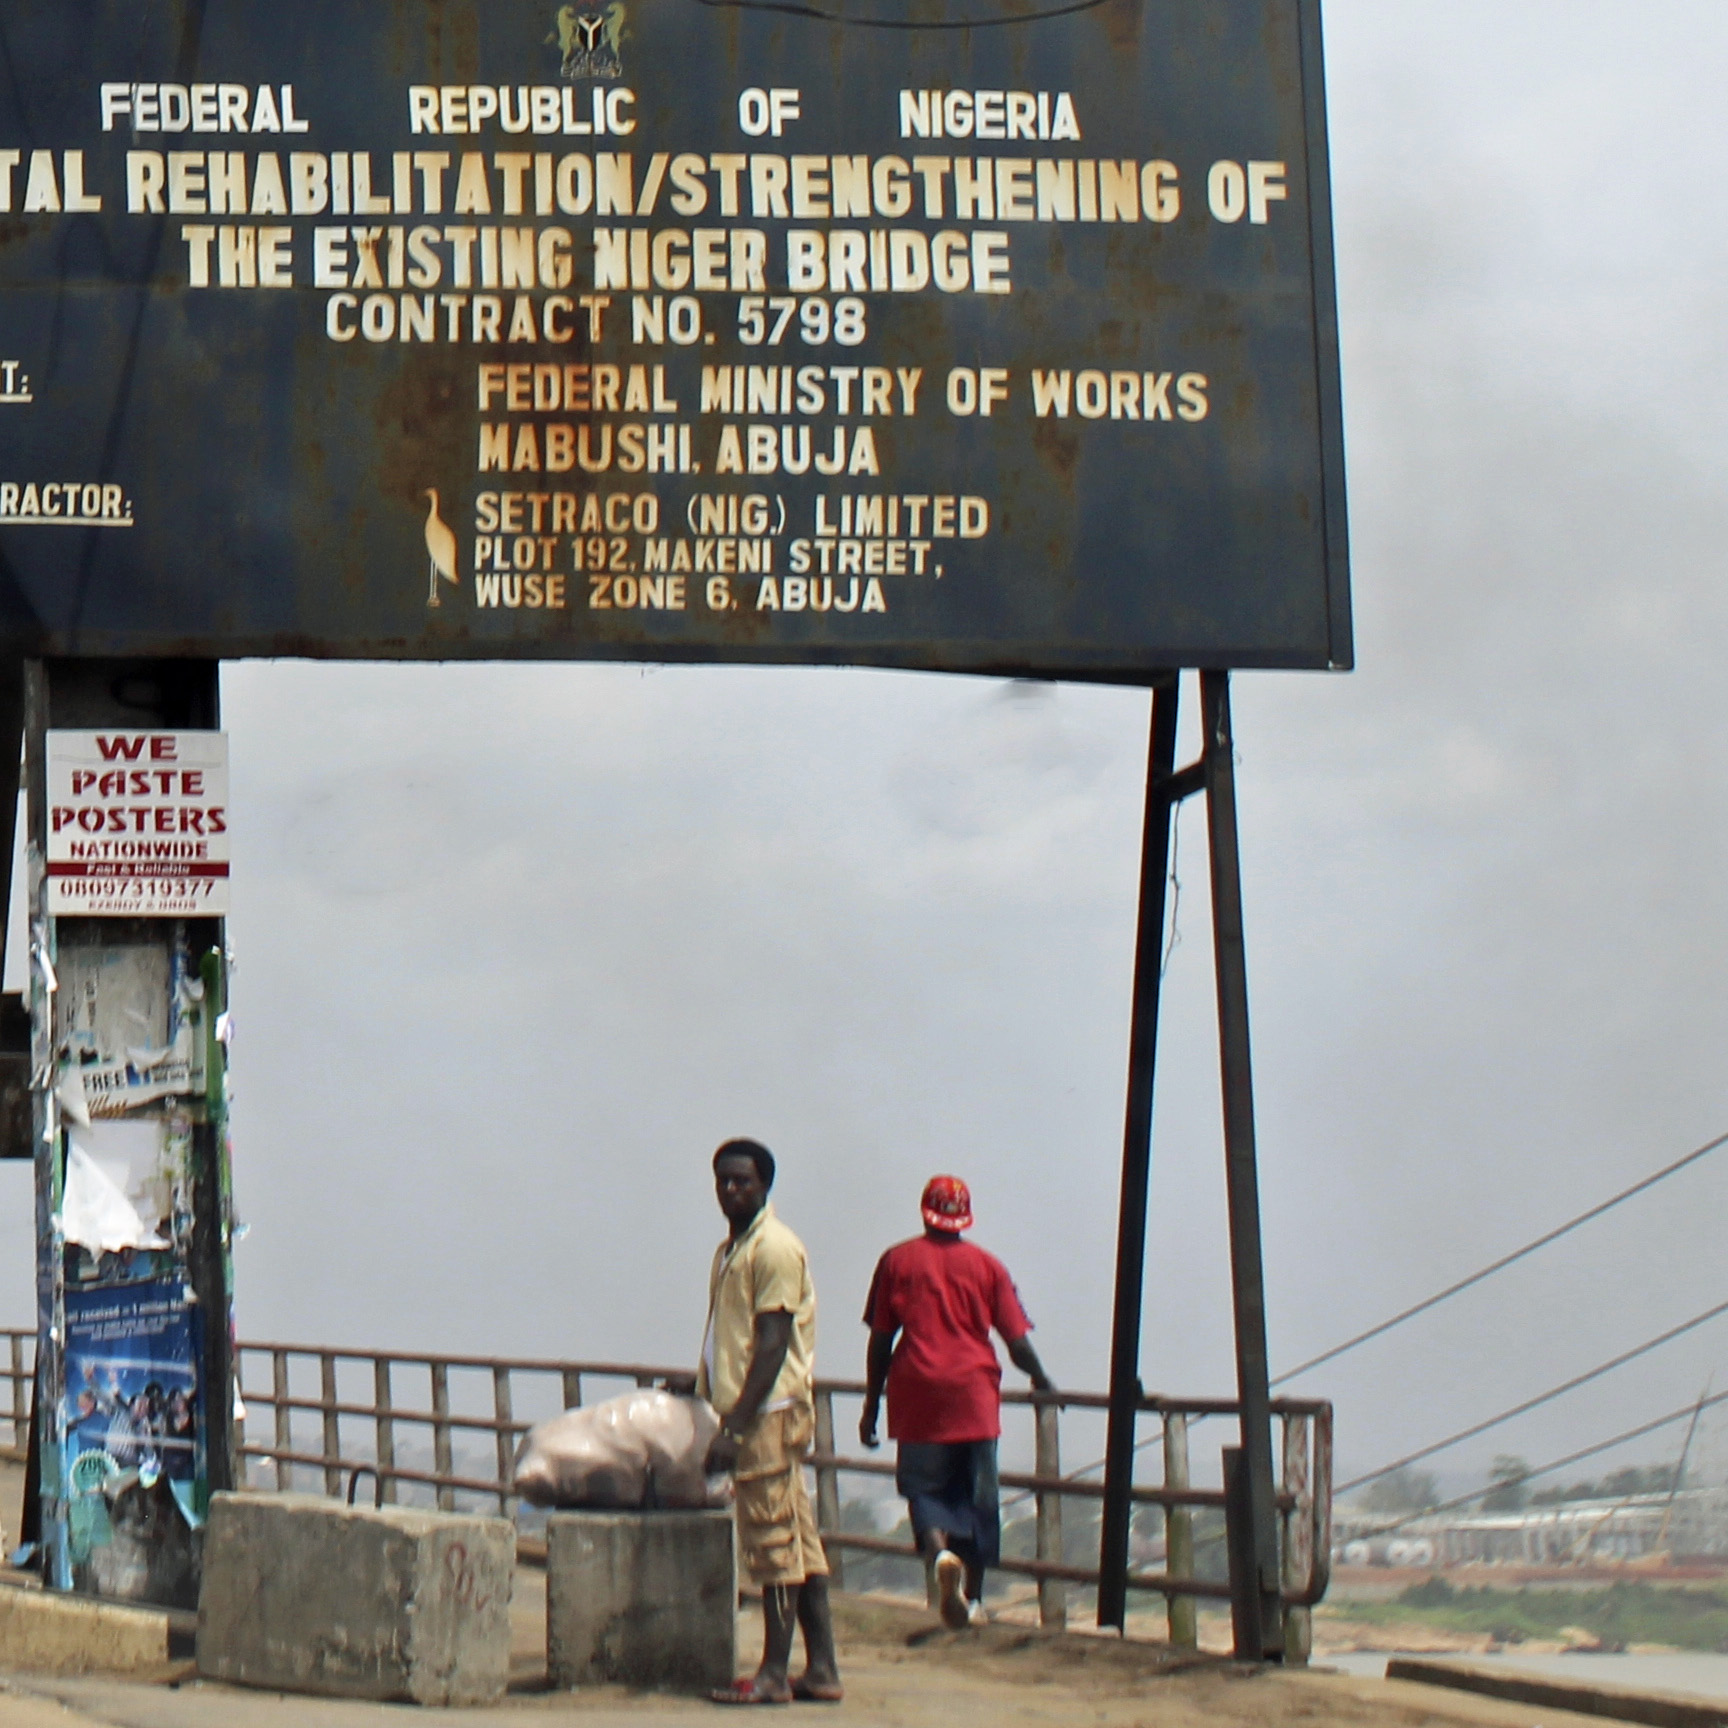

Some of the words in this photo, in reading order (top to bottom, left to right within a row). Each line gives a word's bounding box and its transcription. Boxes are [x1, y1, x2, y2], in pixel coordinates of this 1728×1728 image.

[100, 83, 309, 133] FEDERAL
[409, 86, 636, 136] REPUBLIC
[738, 88, 800, 137] OF
[899, 90, 1081, 141] NIGERIA
[126, 150, 1180, 223] REHABILITATION/STRENGTHENING
[1207, 160, 1287, 224] OF
[181, 225, 294, 288] THE
[313, 226, 573, 290] EXISTING
[594, 227, 766, 292] NIGER
[787, 229, 1011, 294] BRIDGE
[326, 293, 610, 343] CONTRACT
[631, 296, 715, 346] NO.
[738, 297, 867, 347] 5798
[478, 363, 677, 413] FEDERAL
[700, 366, 922, 417] MINISTRY
[946, 368, 1008, 418] OF
[1031, 370, 1209, 422] WORKS
[715, 425, 880, 476] ABUJA
[475, 491, 659, 535] SETRACO
[686, 494, 786, 538] (NIG.)
[816, 495, 990, 539] LIMITED
[474, 536, 557, 572] PLOT
[645, 539, 772, 573] MAKENI
[788, 540, 943, 579] STREET,
[475, 574, 566, 609] WUSE
[588, 575, 686, 610] ZONE
[756, 577, 887, 613] ABUJA
[96, 734, 178, 762] WE
[71, 770, 204, 798] PASTE
[52, 806, 226, 836] POSTERS
[70, 840, 209, 860] NATIONWIDE
